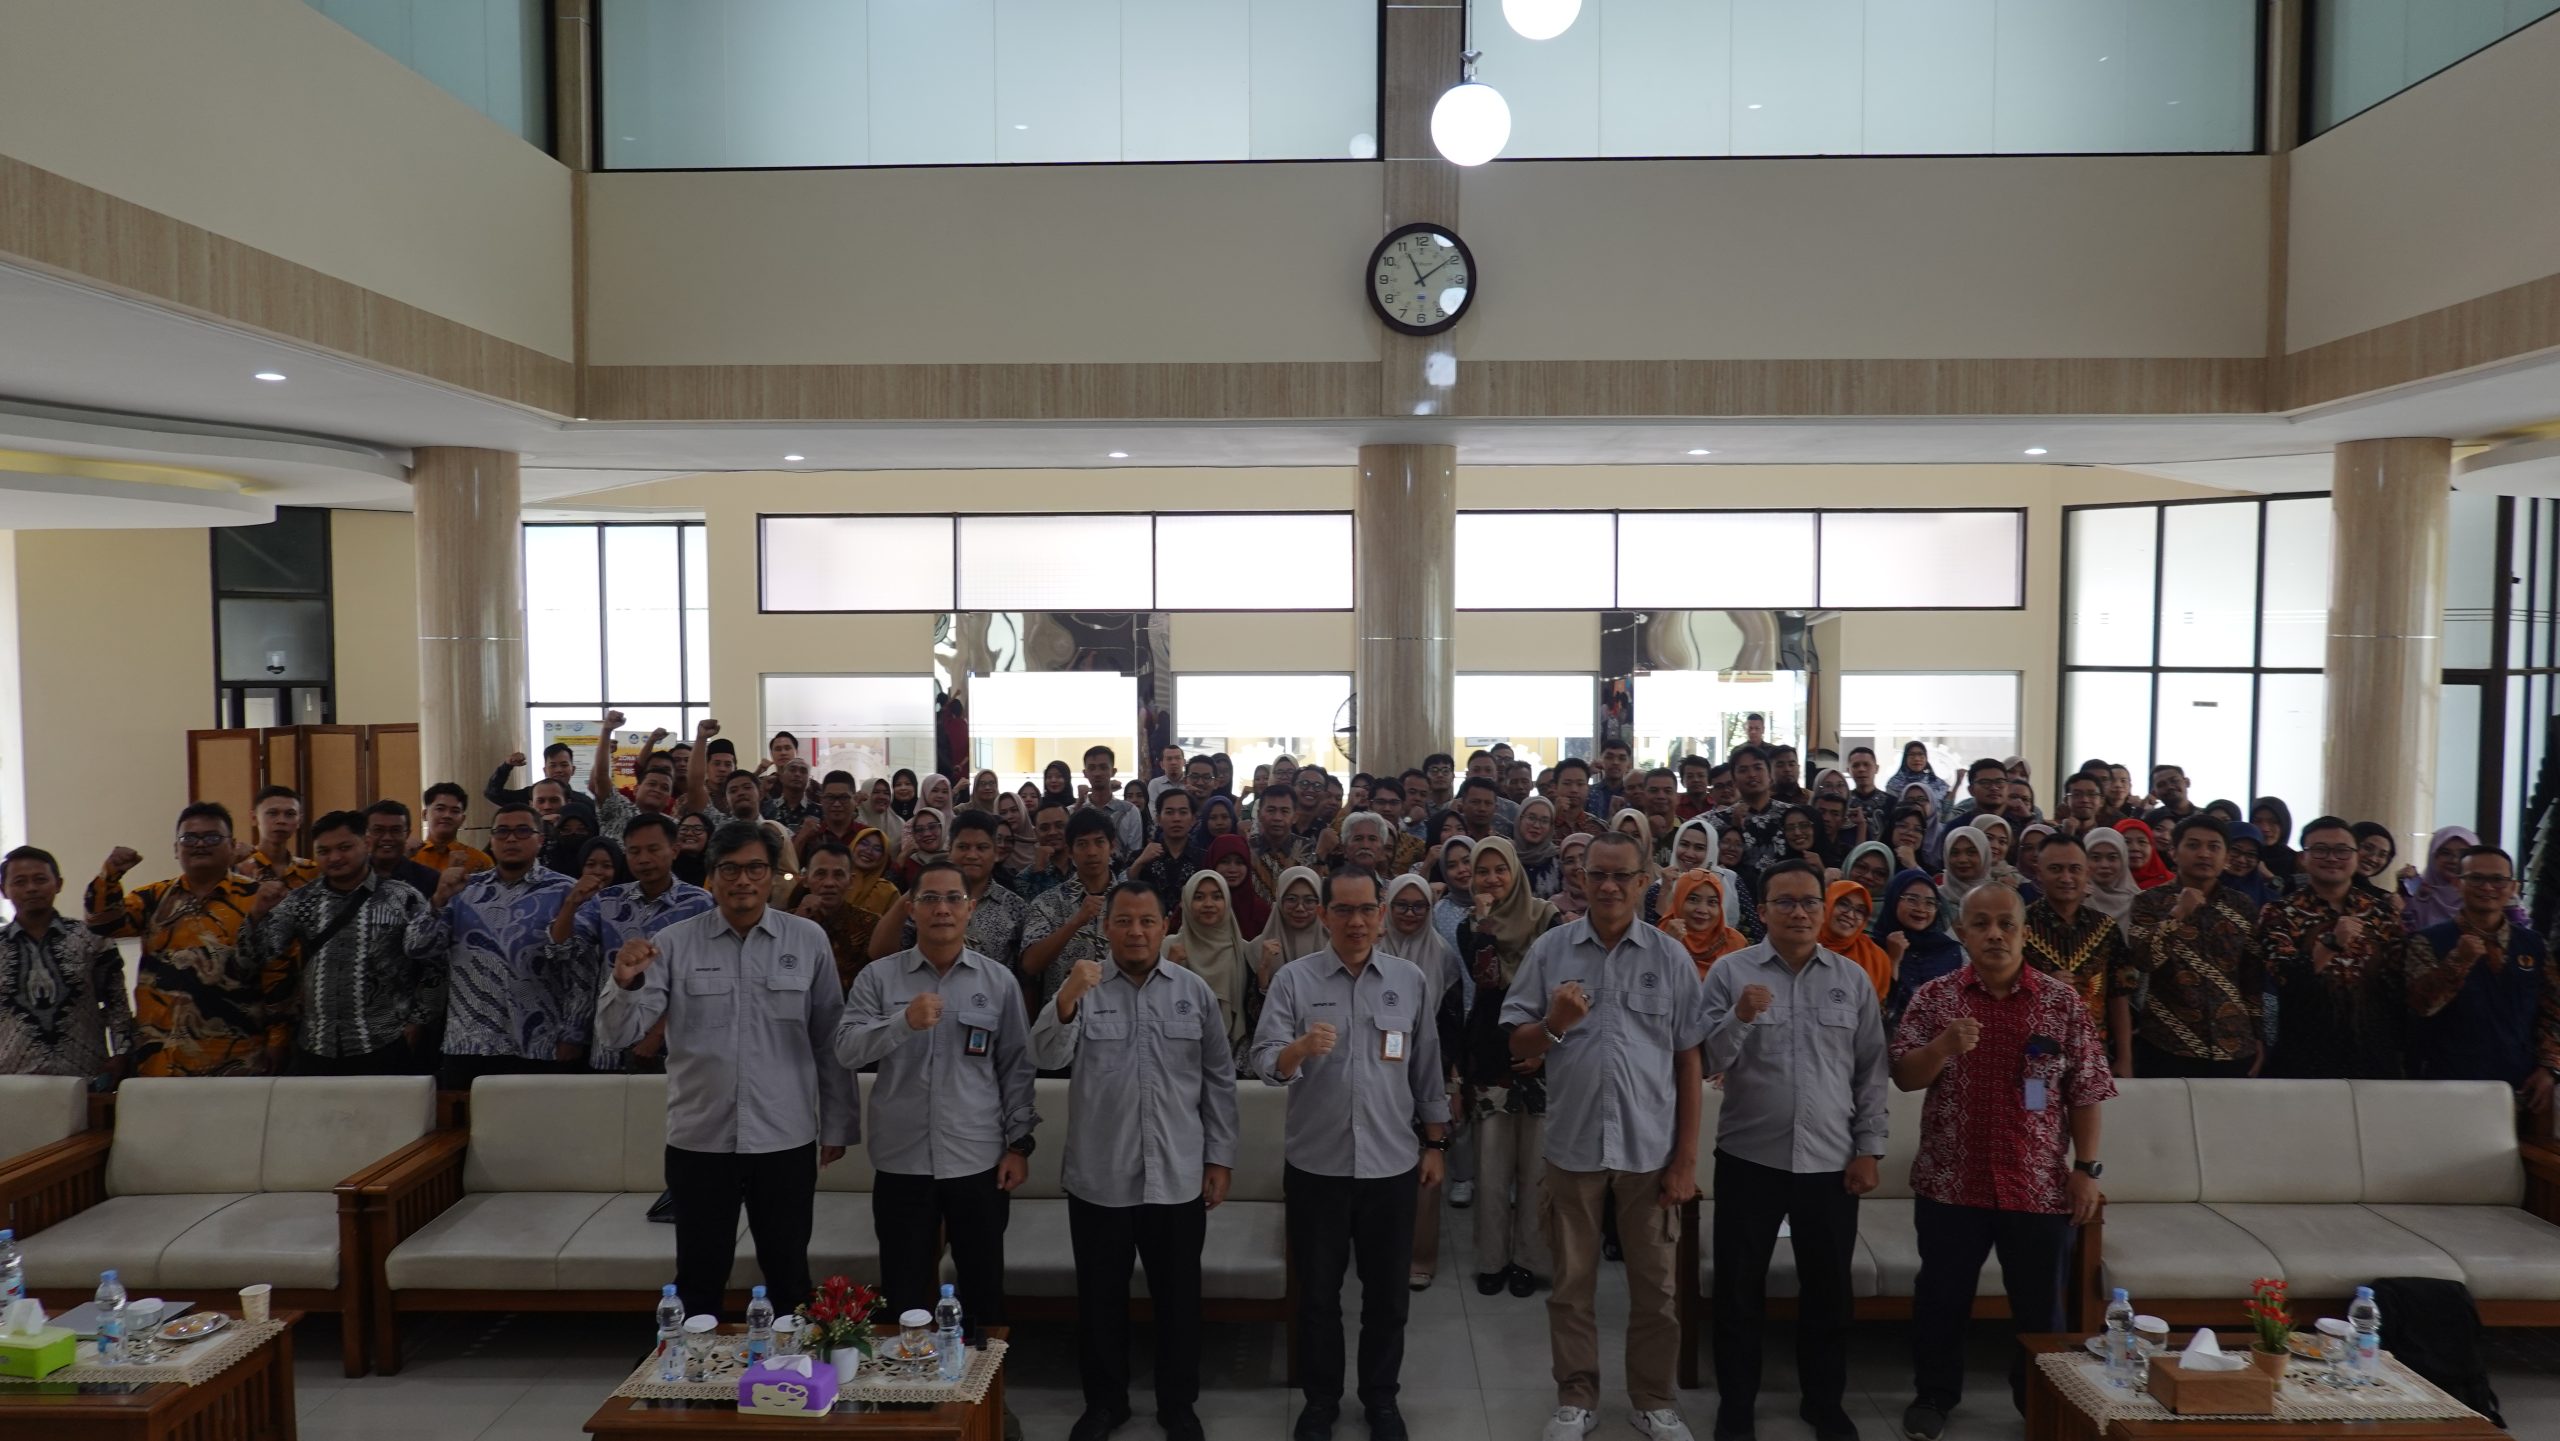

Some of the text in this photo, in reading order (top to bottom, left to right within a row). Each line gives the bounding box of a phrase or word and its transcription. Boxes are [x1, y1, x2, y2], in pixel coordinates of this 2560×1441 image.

[1416, 237, 1429, 246] 12
[1398, 242, 1407, 251] 11
[1383, 257, 1394, 266] 10
[1450, 256, 1459, 264] 2
[1380, 275, 1388, 284] 9
[1455, 275, 1464, 284] 3
[1385, 294, 1394, 303] 8
[1399, 309, 1408, 318] 7
[1436, 308, 1445, 317] 5
[1417, 314, 1426, 323] 6
